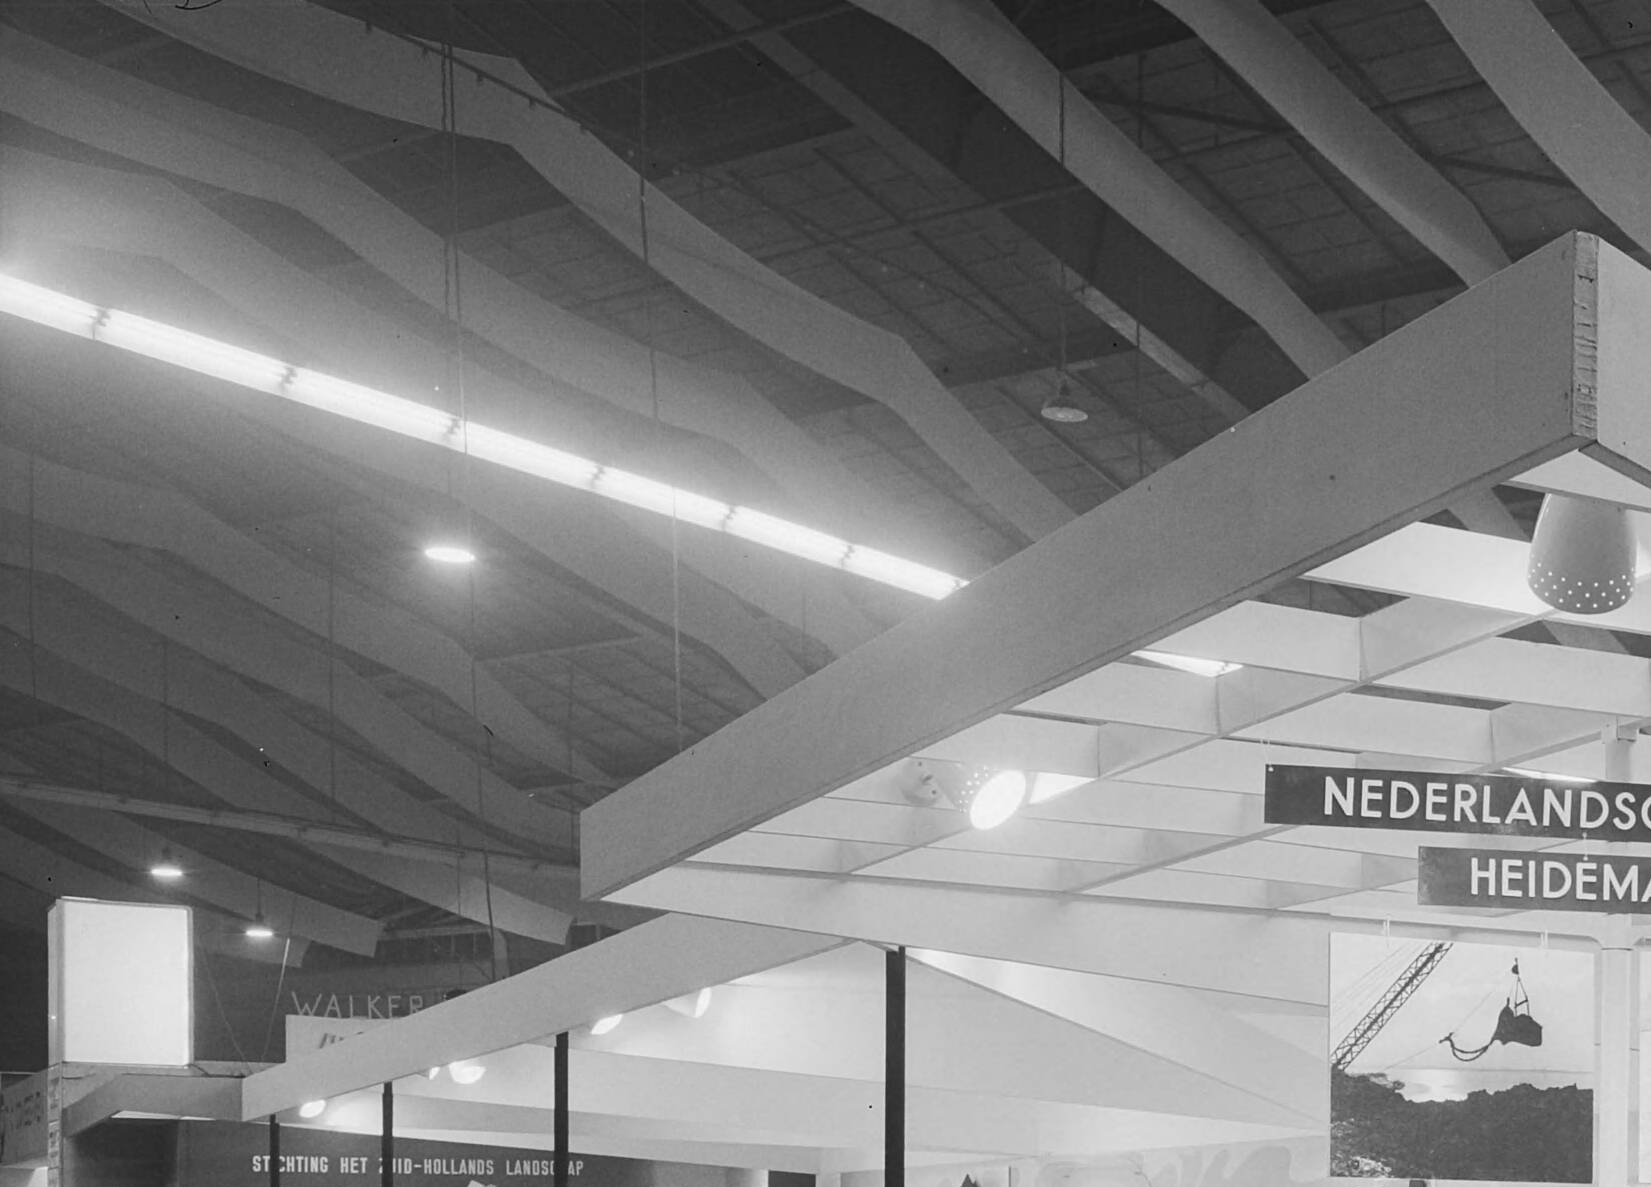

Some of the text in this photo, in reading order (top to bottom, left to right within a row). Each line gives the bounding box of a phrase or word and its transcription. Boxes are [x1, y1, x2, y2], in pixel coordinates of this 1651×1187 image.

[252, 1155, 329, 1173] STCHTING
[340, 1157, 368, 1174] HET
[506, 1159, 584, 1176] LANDSCAP
